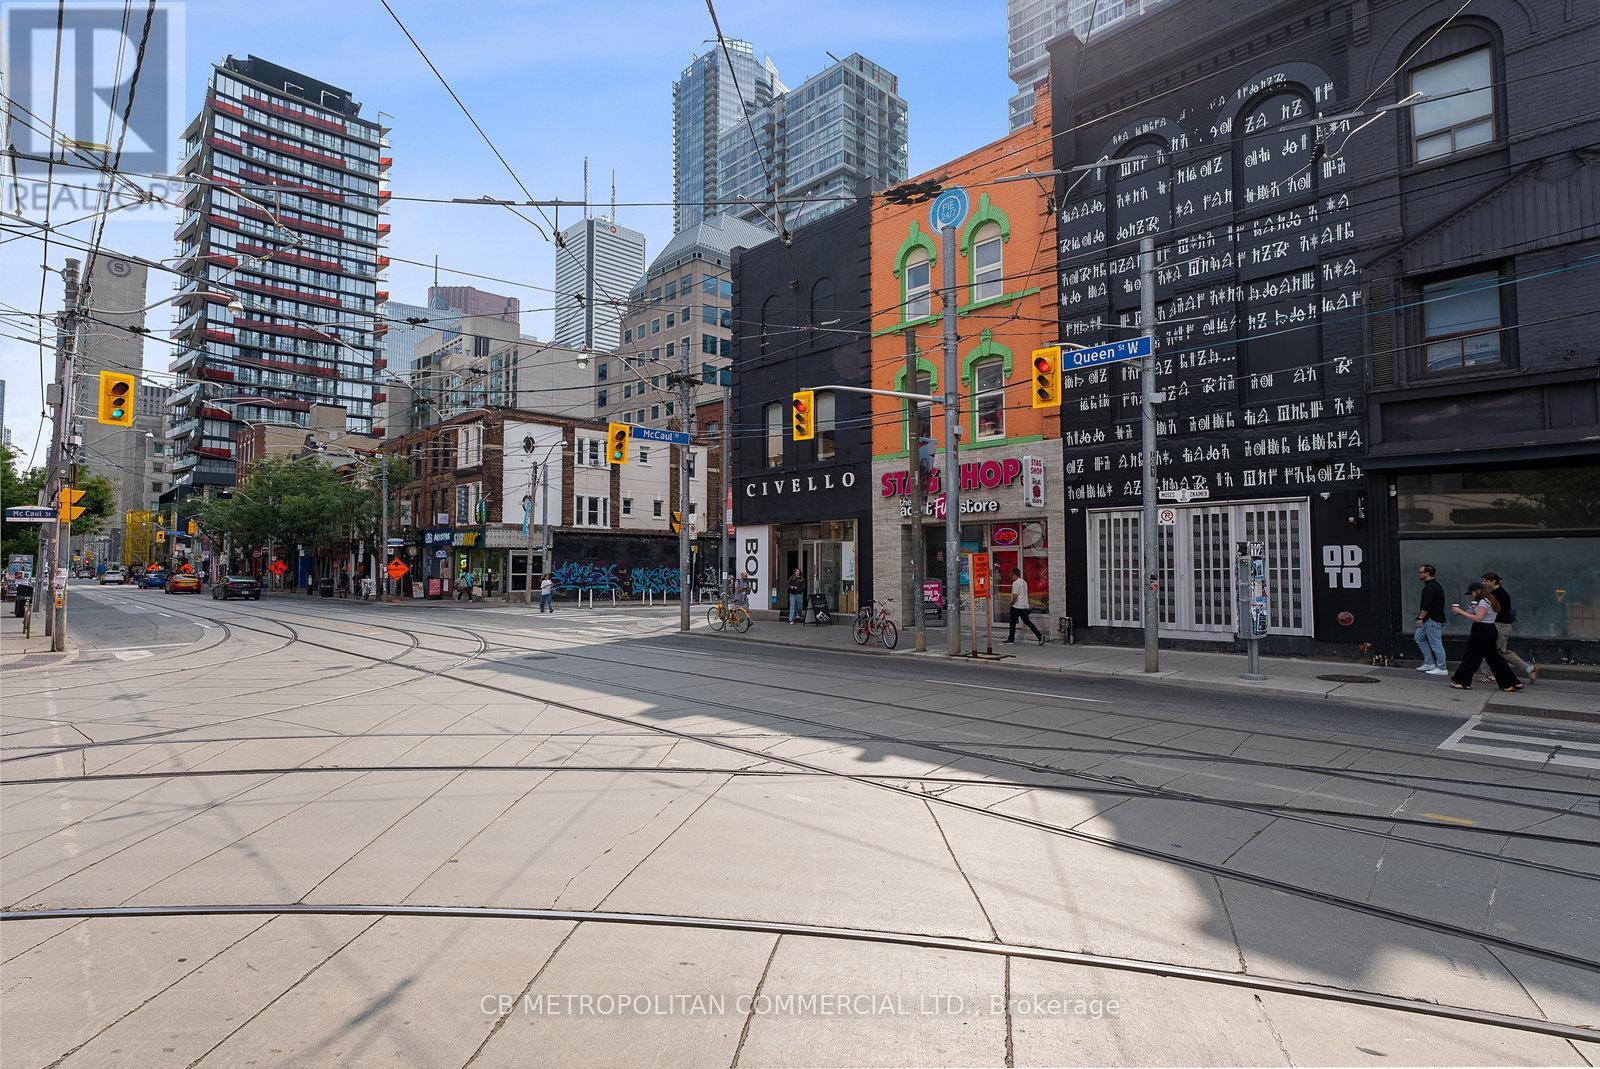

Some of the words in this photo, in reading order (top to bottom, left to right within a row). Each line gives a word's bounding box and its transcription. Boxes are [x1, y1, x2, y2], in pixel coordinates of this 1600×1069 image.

[1073, 349, 1115, 365] Queen
[1127, 341, 1139, 354] W
[643, 430, 673, 440] McCaul
[746, 472, 855, 497] CIVELLO
[957, 457, 1022, 491] HOP
[900, 498, 912, 507] the
[959, 499, 998, 514] store
[451, 531, 480, 547] SUBWAY
[1322, 545, 1363, 567] OD
[1324, 567, 1362, 588] TO
